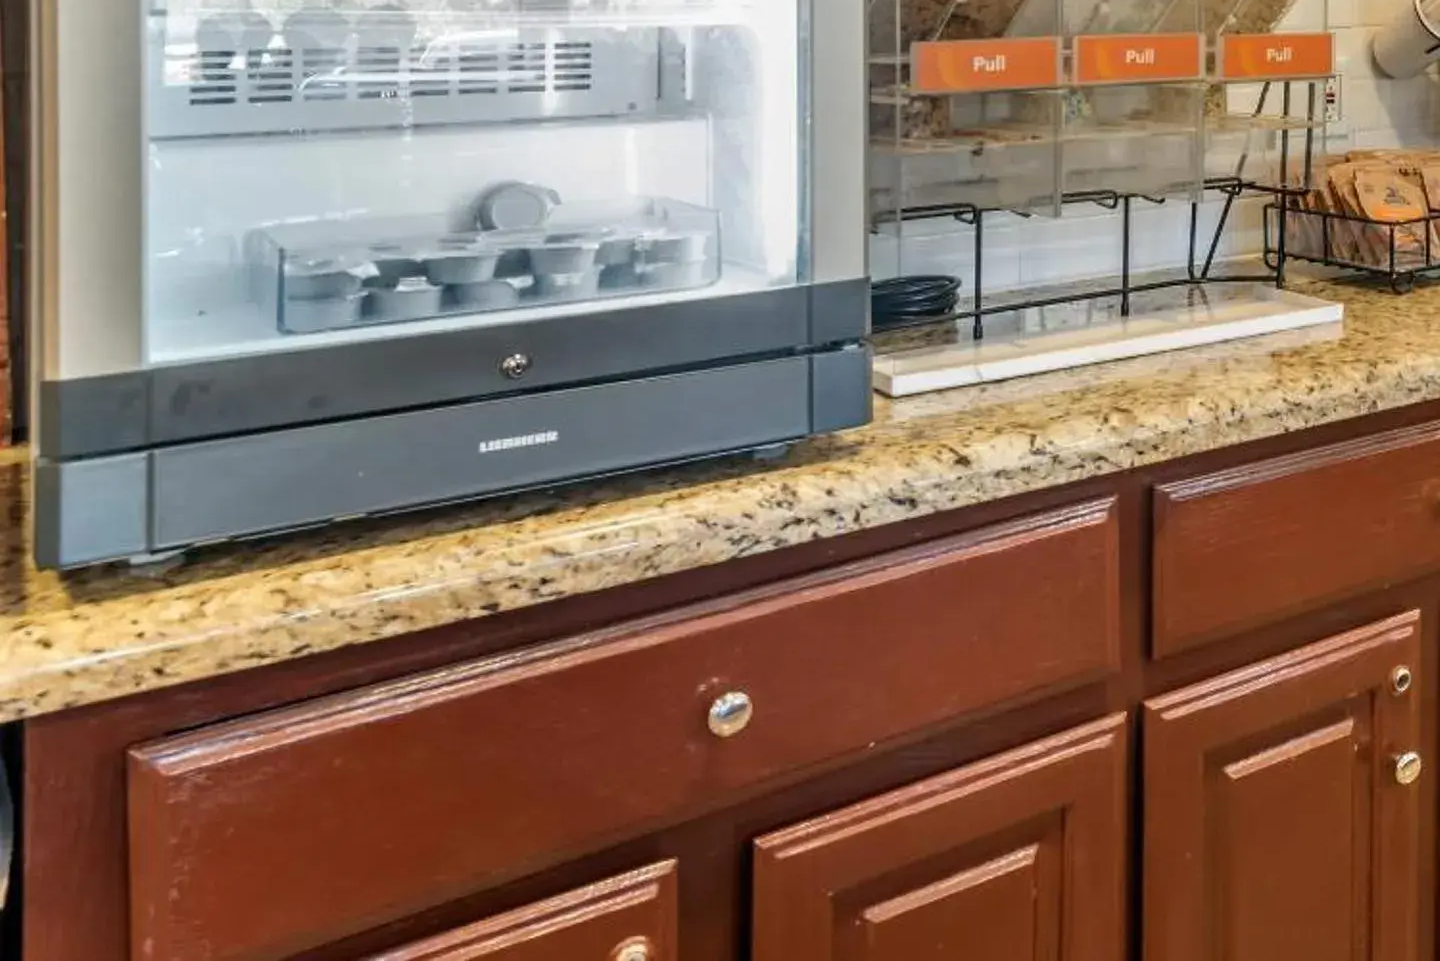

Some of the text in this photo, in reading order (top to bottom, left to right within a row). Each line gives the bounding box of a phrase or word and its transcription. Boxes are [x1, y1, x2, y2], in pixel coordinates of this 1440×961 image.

[1126, 48, 1155, 66] Pull
[1266, 46, 1293, 63] Pull
[973, 55, 1006, 72] Pull
